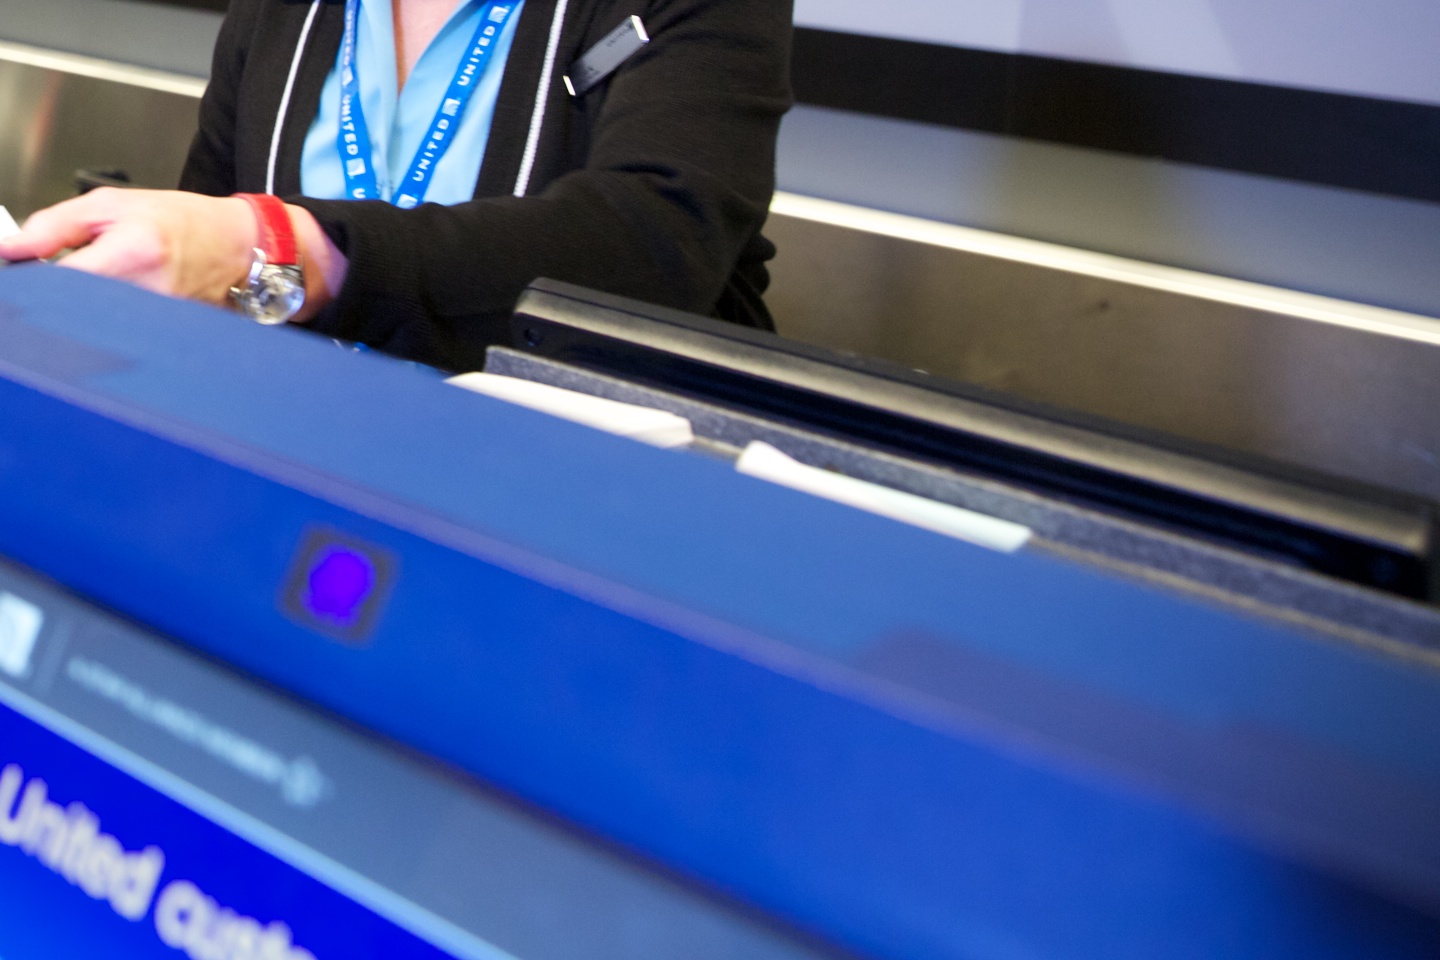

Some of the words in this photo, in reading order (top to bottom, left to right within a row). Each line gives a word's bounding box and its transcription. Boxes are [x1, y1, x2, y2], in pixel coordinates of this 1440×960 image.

[457, 25, 496, 87] UNITED
[342, 94, 359, 155] UNITED
[412, 117, 450, 182] UNITED
